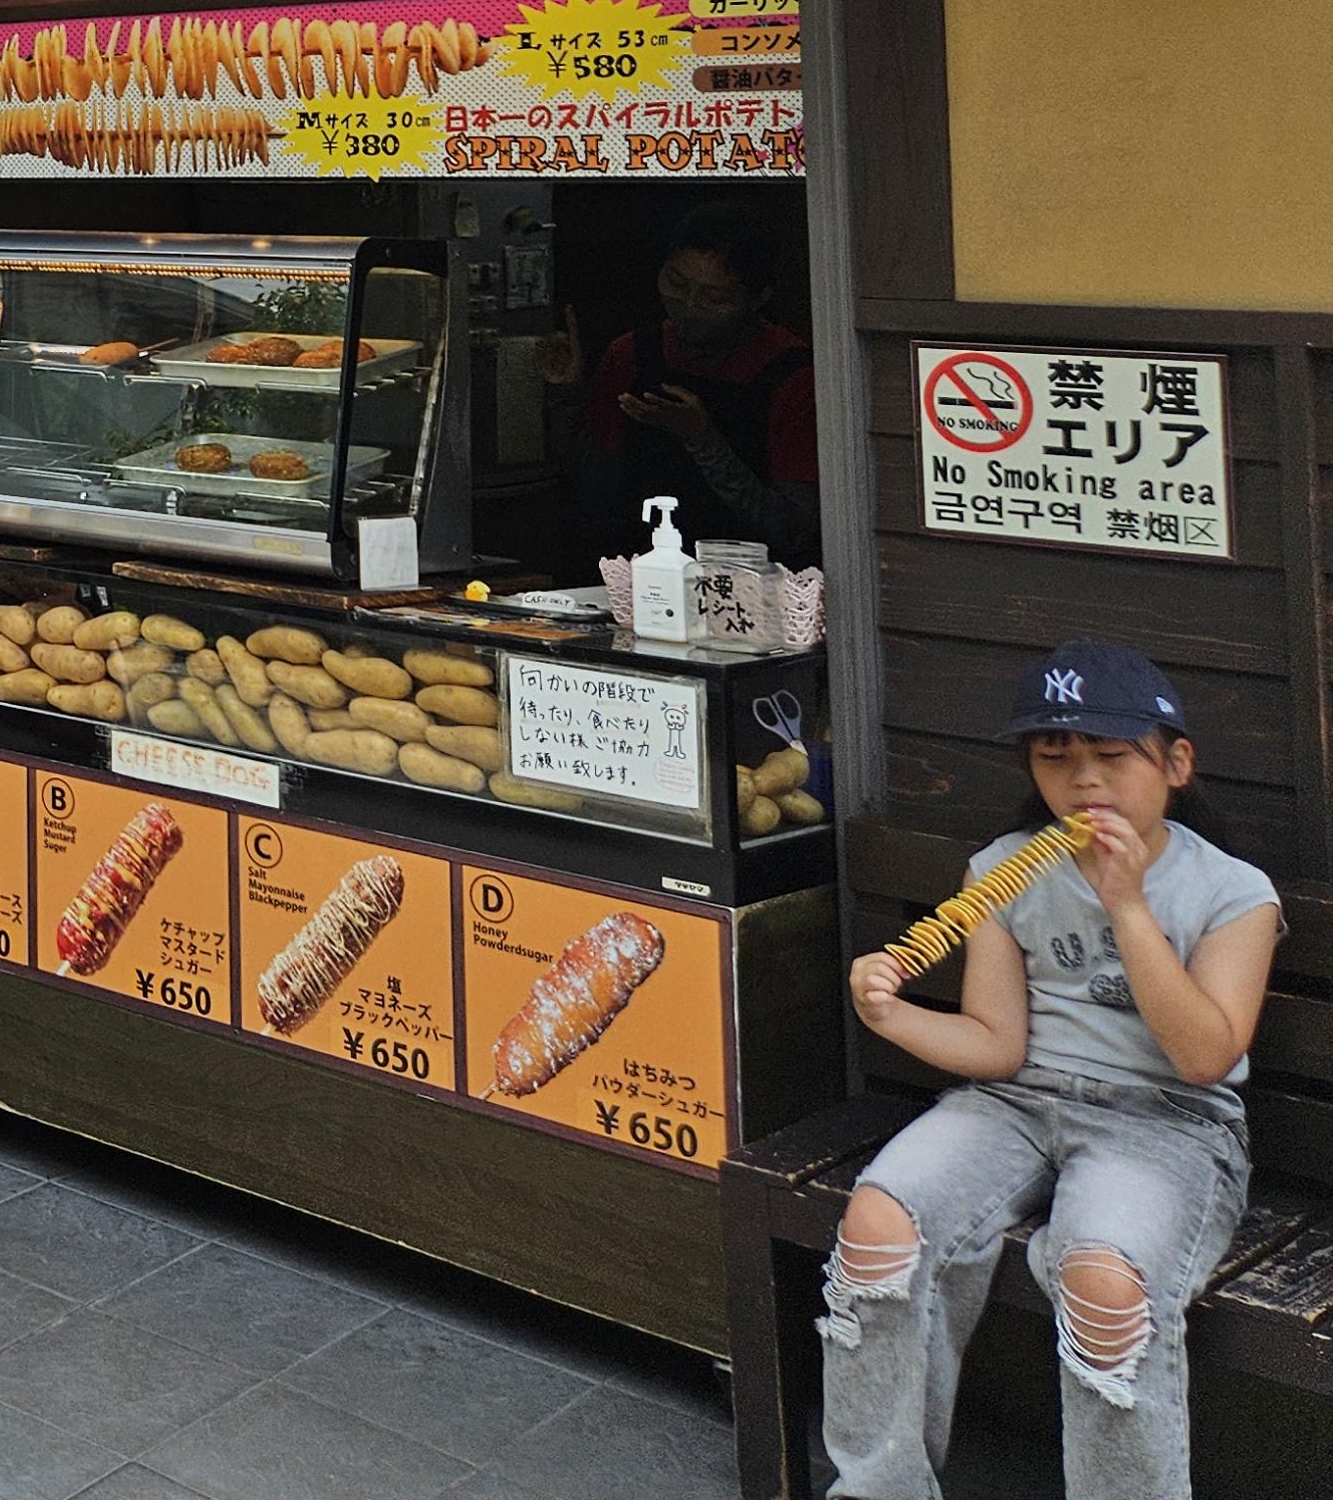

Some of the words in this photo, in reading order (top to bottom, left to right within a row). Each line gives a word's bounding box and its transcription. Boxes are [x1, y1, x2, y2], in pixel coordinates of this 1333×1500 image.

[516, 31, 543, 51] L
[549, 31, 602, 51] サイズ
[617, 29, 646, 49] 53
[649, 32, 670, 47] cm
[547, 49, 638, 80] ¥580
[296, 111, 322, 131] M
[325, 111, 369, 131] サイズ
[386, 110, 414, 129] 30
[445, 101, 796, 133] 日本一のスパイラルポテト
[321, 132, 400, 157] ¥380
[443, 132, 610, 174] SPIRAL
[1047, 359, 1200, 417] 禁煙
[936, 416, 956, 430] NO
[958, 417, 1019, 433] SMOKING
[1041, 418, 1211, 468] エリア
[932, 455, 966, 485] No
[987, 459, 1117, 500] Smoking
[1138, 477, 1217, 506] area
[931, 490, 1083, 535] 금연구역
[1106, 507, 1220, 546] 禁烟区
[694, 575, 733, 599] 不要
[519, 664, 656, 703] 向かいの階段で
[1044, 667, 1085, 704] NY
[519, 696, 650, 735] 待ったり、食べたり
[213, 754, 270, 790] DOG
[43, 817, 77, 835] Ketchup
[43, 829, 76, 845] Mustard
[43, 839, 68, 855] Suger
[247, 866, 267, 881] Salt
[247, 879, 306, 902] Mayonnaise
[247, 891, 309, 916] Blackpepper
[159, 917, 225, 946] ケチャップ
[472, 921, 509, 941] Honey
[159, 934, 226, 964] マスタード
[160, 951, 214, 975] シュガー
[472, 936, 554, 965] Powderdsugar
[135, 969, 211, 1016] ¥650
[386, 975, 402, 995] 塩
[358, 988, 433, 1022] マヨネーズ
[339, 1001, 454, 1043] ブラックペッパー
[341, 1027, 430, 1080] ¥650
[623, 1057, 696, 1092] はちみつ
[592, 1074, 725, 1120] パウダーシュガー
[593, 1099, 698, 1159] ¥650
